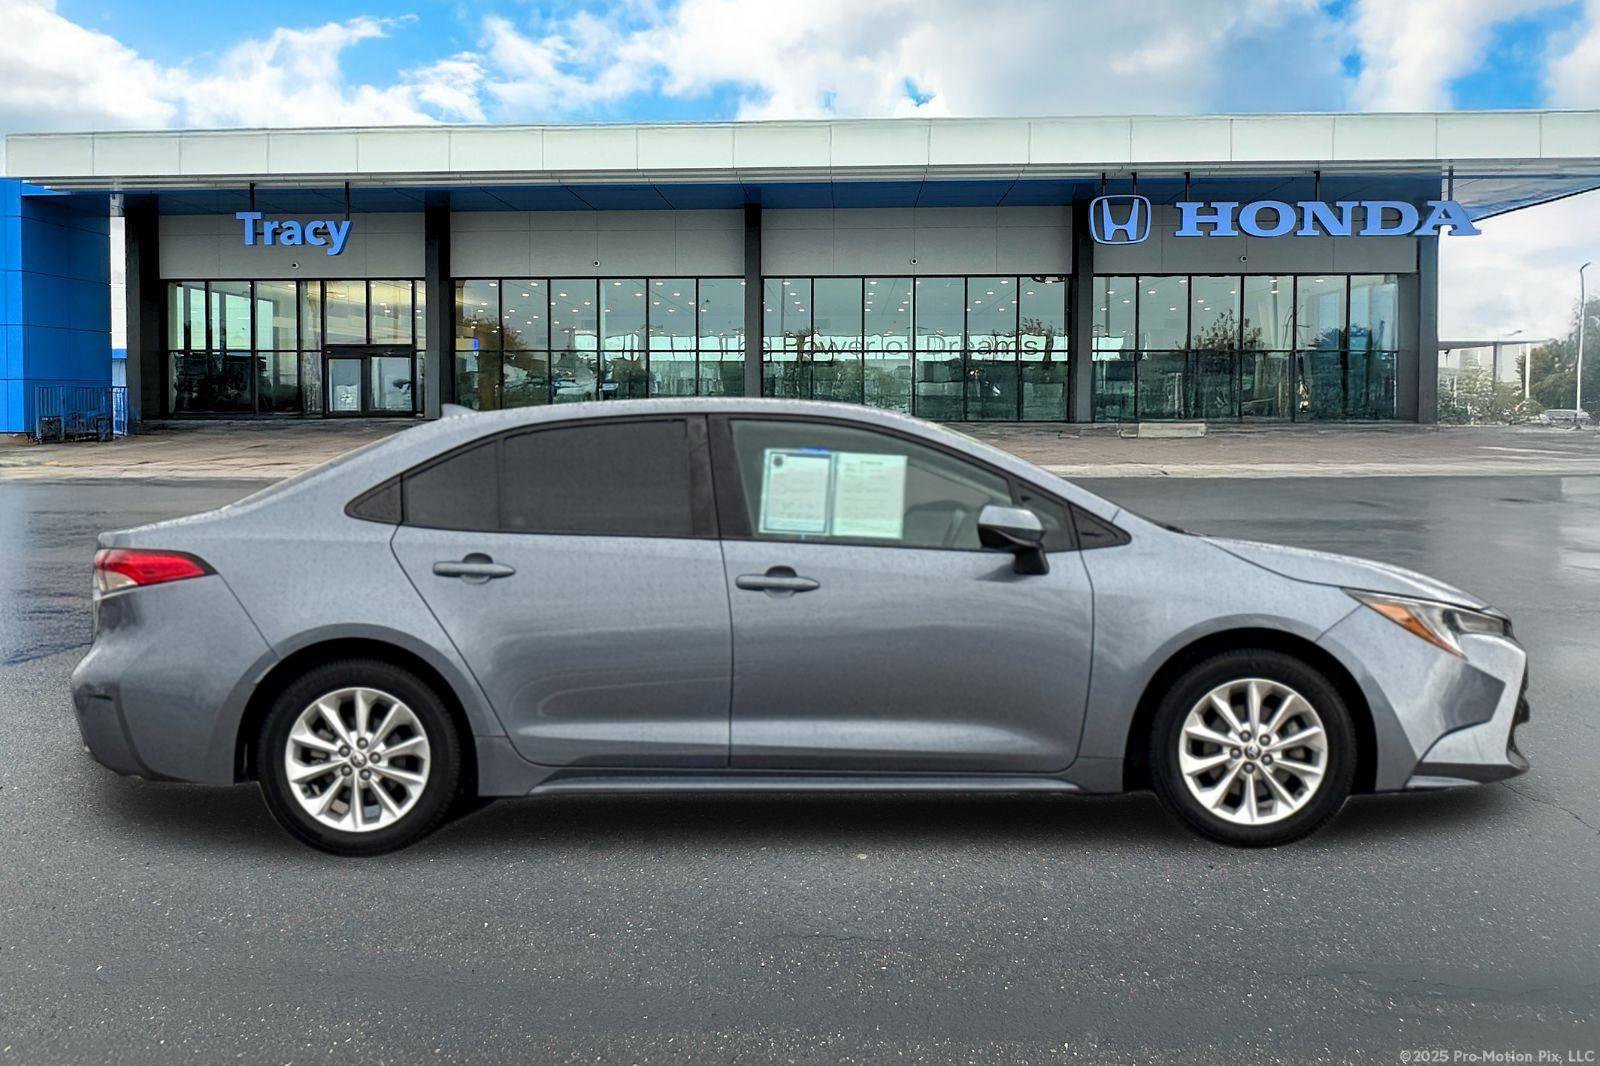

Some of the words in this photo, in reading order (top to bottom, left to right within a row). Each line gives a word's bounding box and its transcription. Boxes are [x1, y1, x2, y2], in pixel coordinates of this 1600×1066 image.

[235, 211, 352, 256] Tracy
[1174, 199, 1483, 238] HONDA
[783, 335, 876, 356] Power
[926, 335, 1038, 356] Dreams
